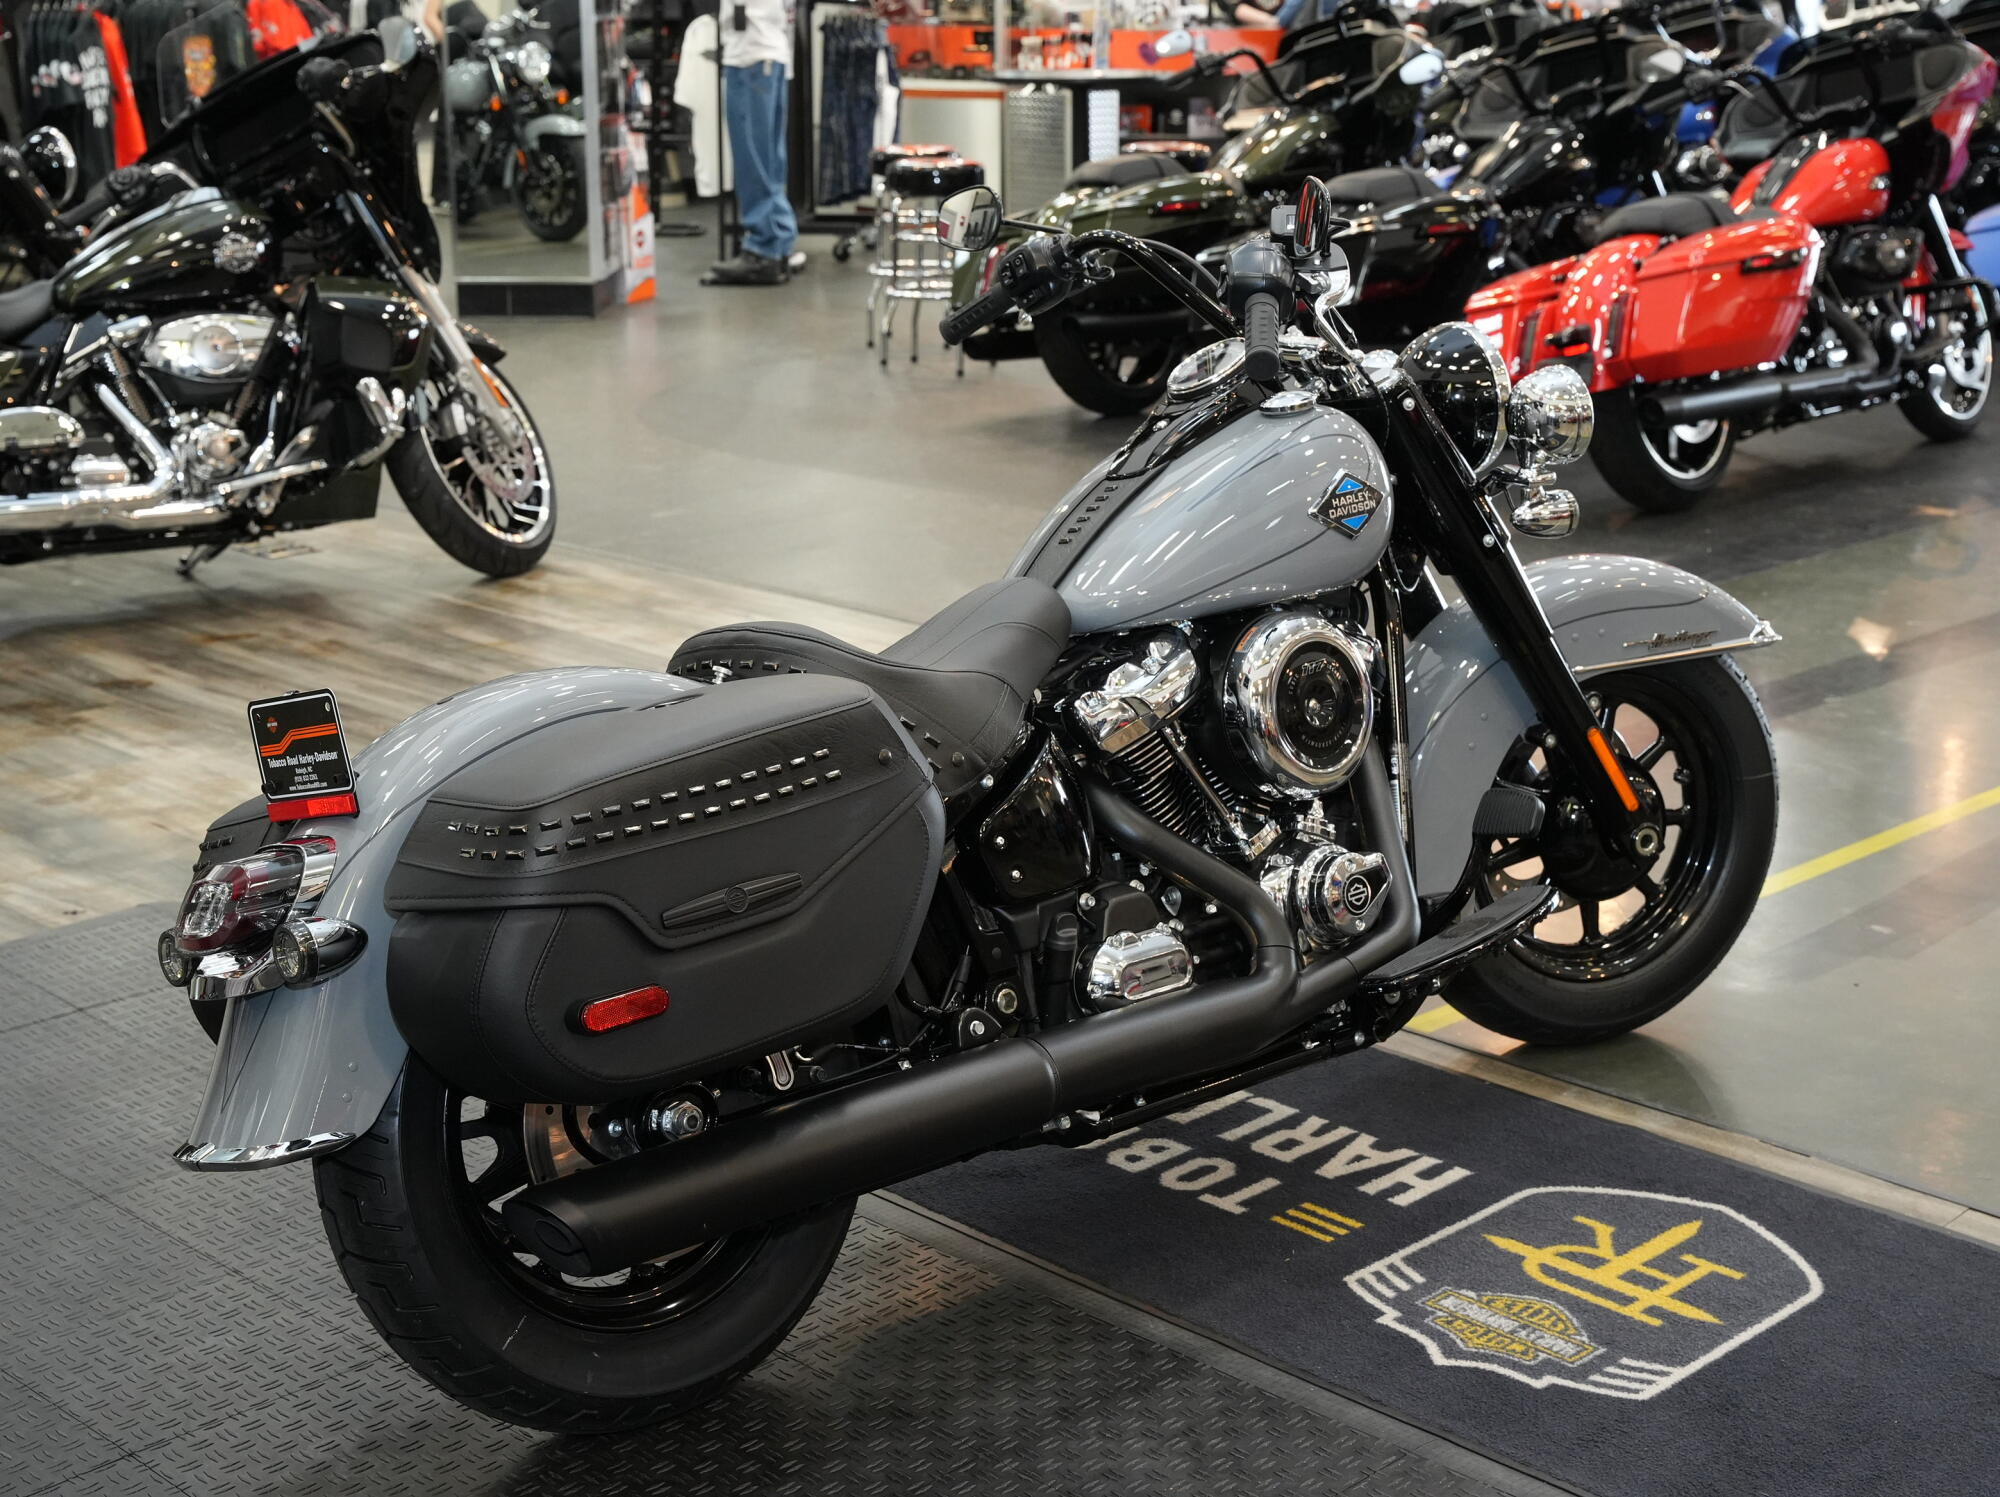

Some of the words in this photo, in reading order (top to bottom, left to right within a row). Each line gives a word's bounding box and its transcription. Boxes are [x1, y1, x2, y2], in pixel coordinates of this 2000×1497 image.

[1332, 491, 1372, 507] HARLEY-
[1328, 500, 1376, 519] DAVIDSON
[1301, 658, 1327, 677] 117
[267, 757, 287, 769] Tobacco
[287, 755, 299, 766] Road
[299, 751, 338, 765] Harley-Davidson
